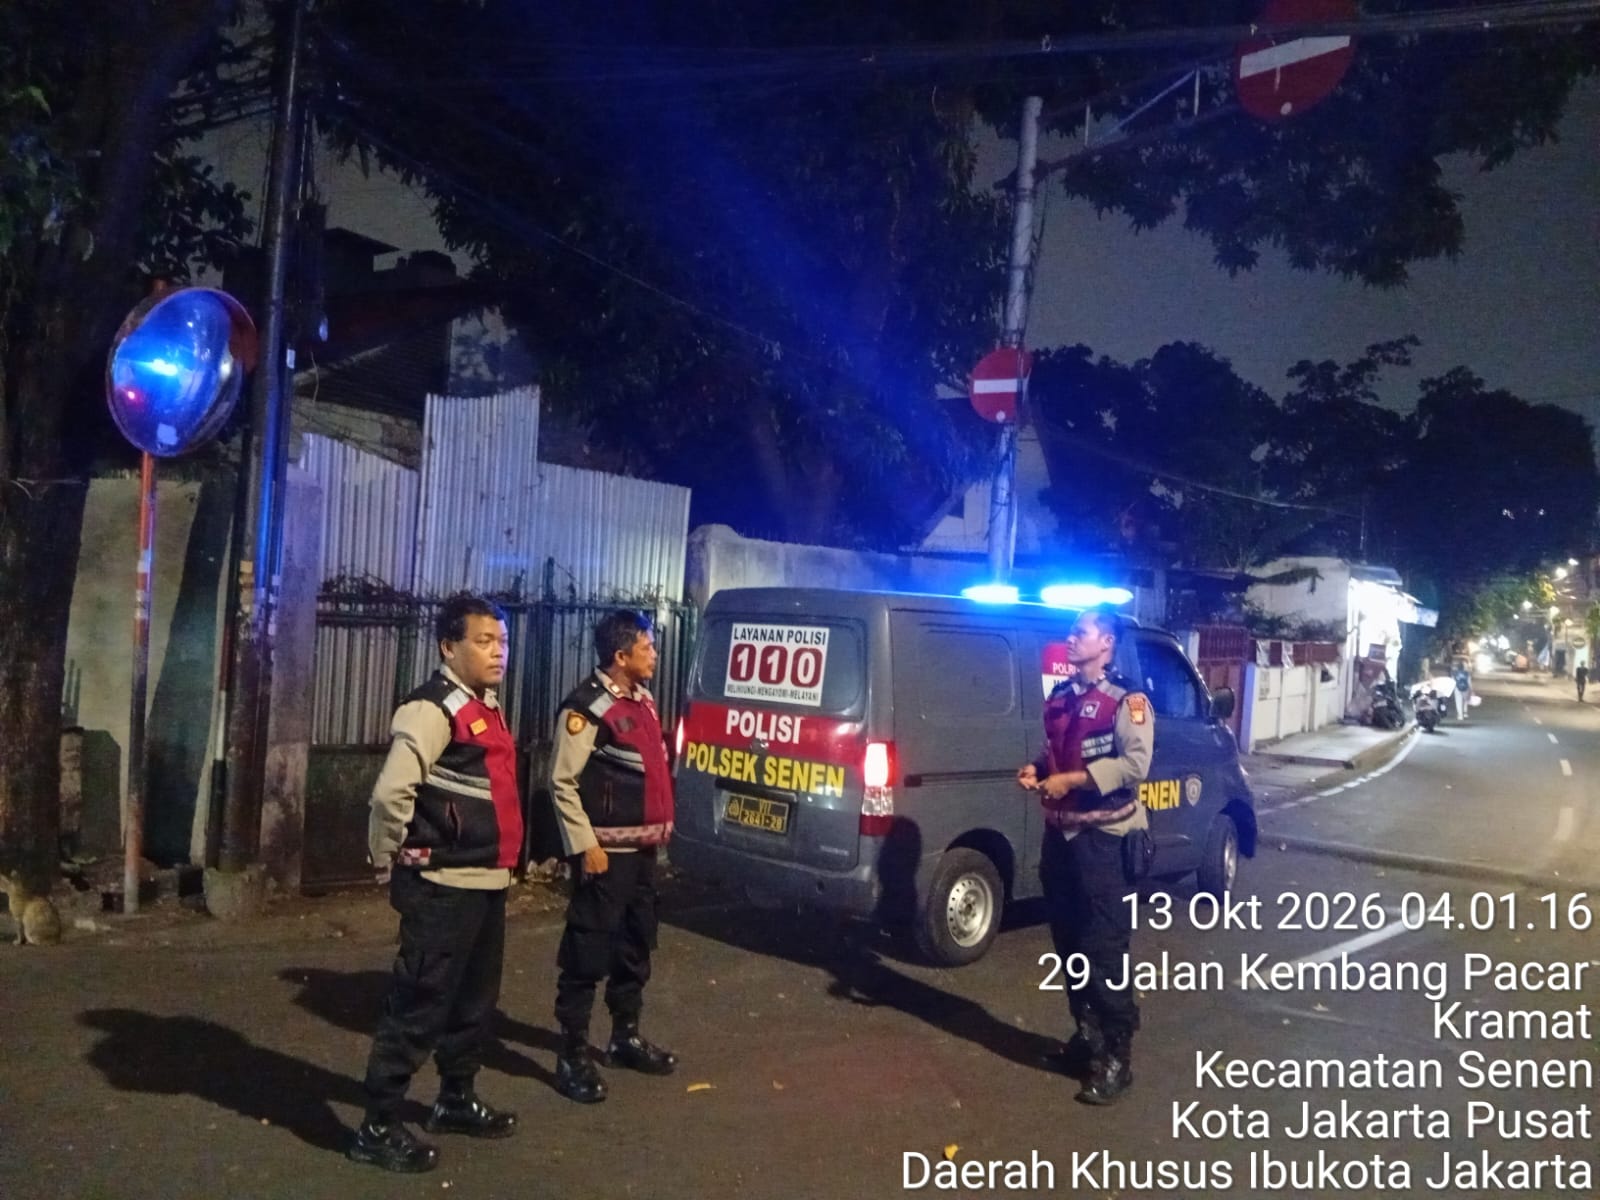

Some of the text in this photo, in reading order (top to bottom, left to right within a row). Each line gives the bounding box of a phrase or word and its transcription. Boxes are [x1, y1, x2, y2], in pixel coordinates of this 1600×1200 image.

[734, 627, 826, 646] LAYANAN POLISI
[737, 647, 816, 685] 110
[726, 709, 801, 744] POLISI
[686, 741, 844, 798] POLSEK SENEN
[1138, 779, 1180, 811] ENEN
